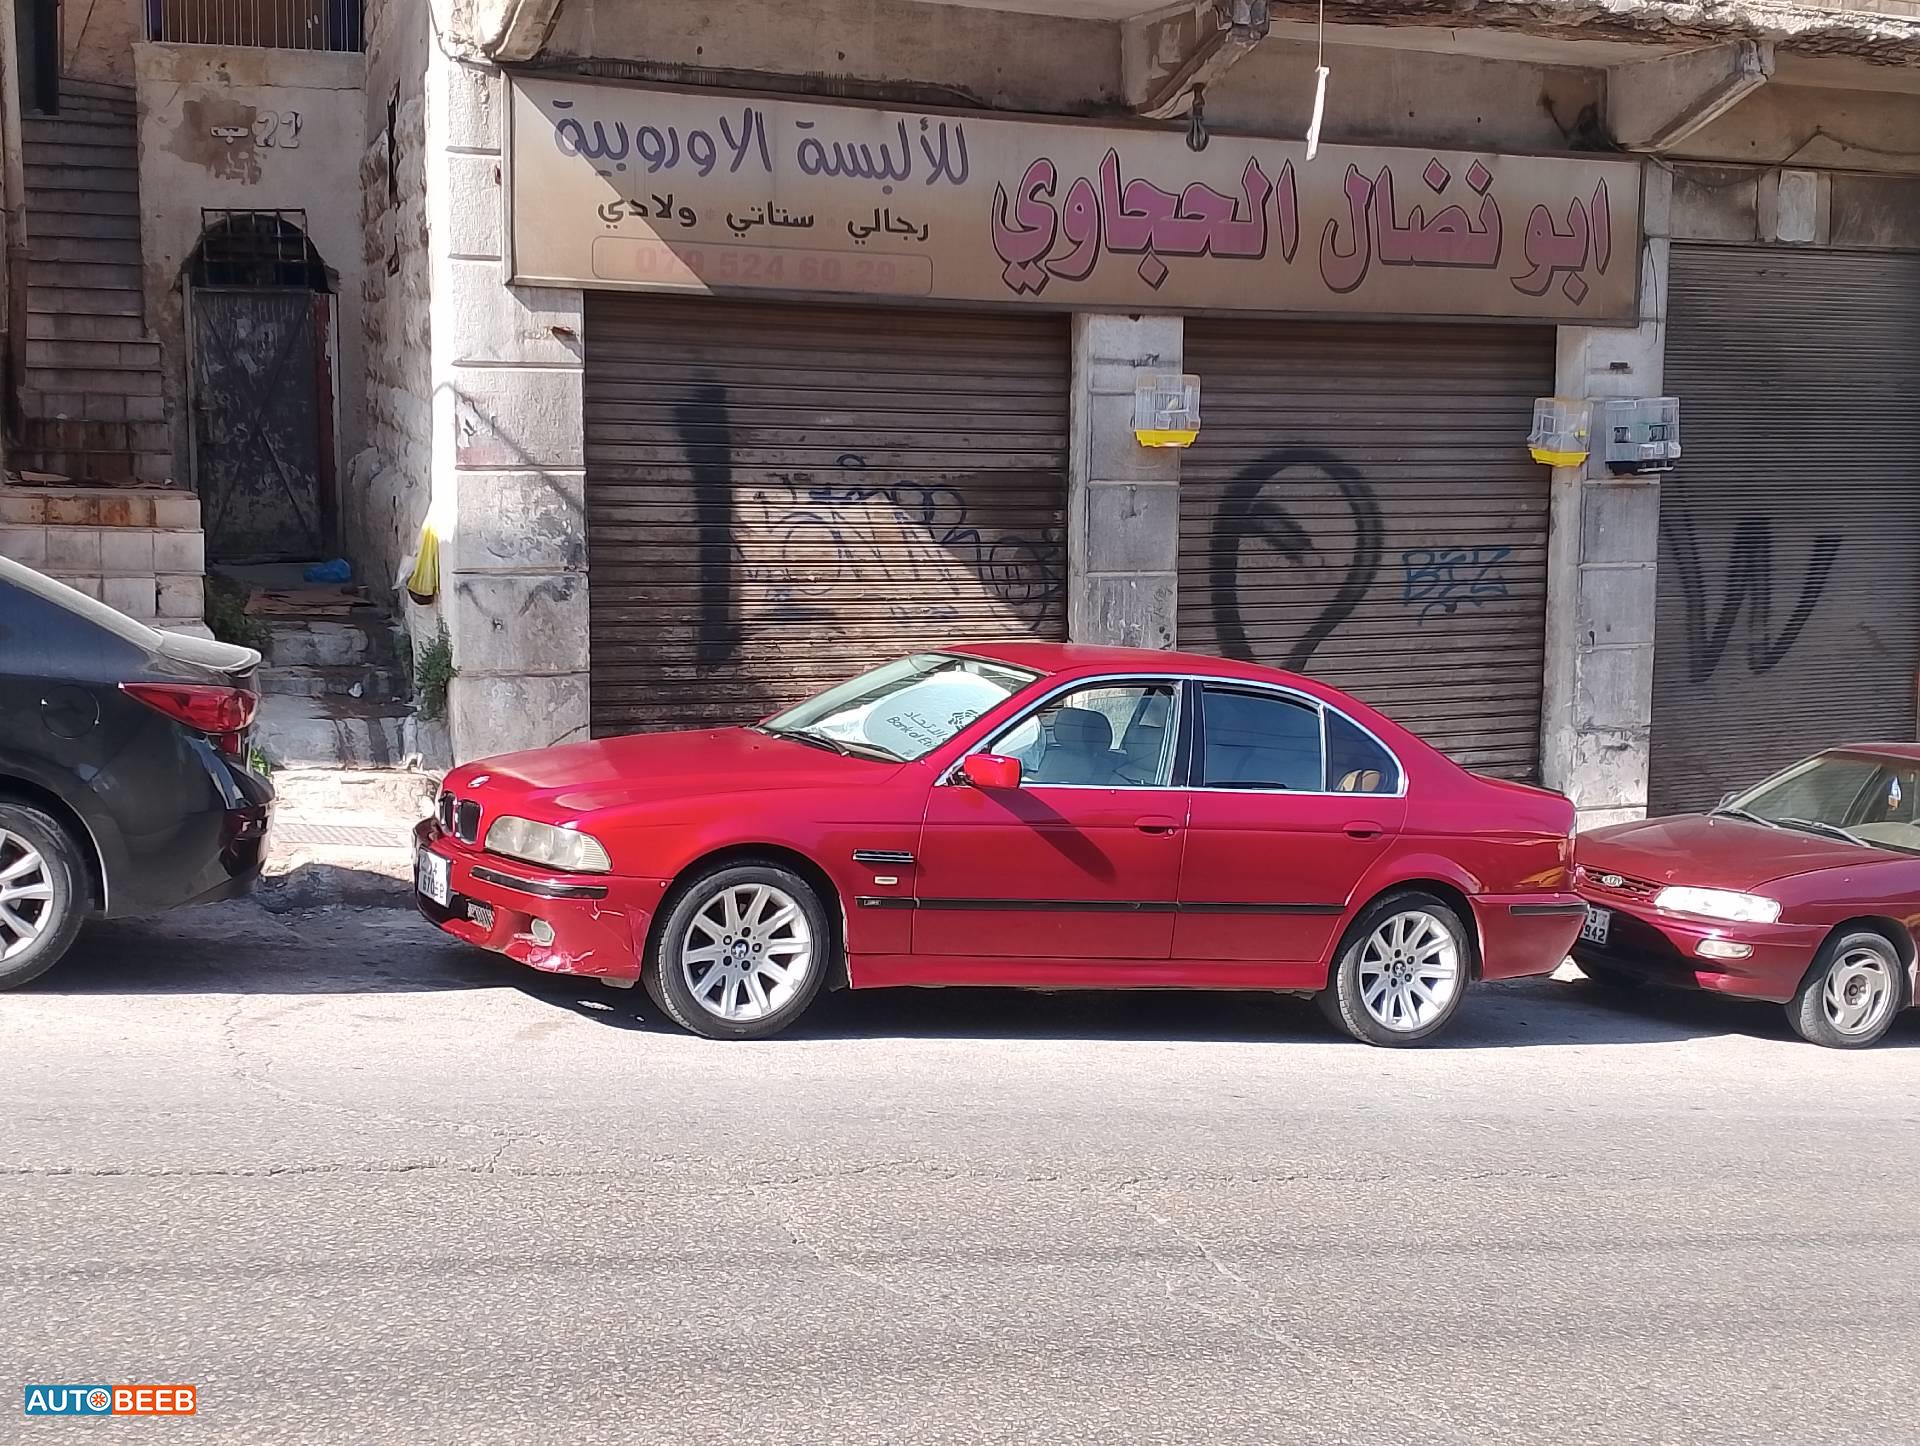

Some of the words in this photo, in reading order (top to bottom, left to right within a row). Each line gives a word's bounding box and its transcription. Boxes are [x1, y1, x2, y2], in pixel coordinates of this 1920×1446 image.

[597, 193, 698, 229] ولادي
[847, 207, 930, 244] رجالي
[991, 146, 1300, 296] الحجاوي
[1319, 157, 1503, 294] نضال
[1510, 176, 1612, 305] ابو
[719, 252, 784, 281] 524
[799, 257, 841, 284] 60
[855, 260, 896, 286] 29
